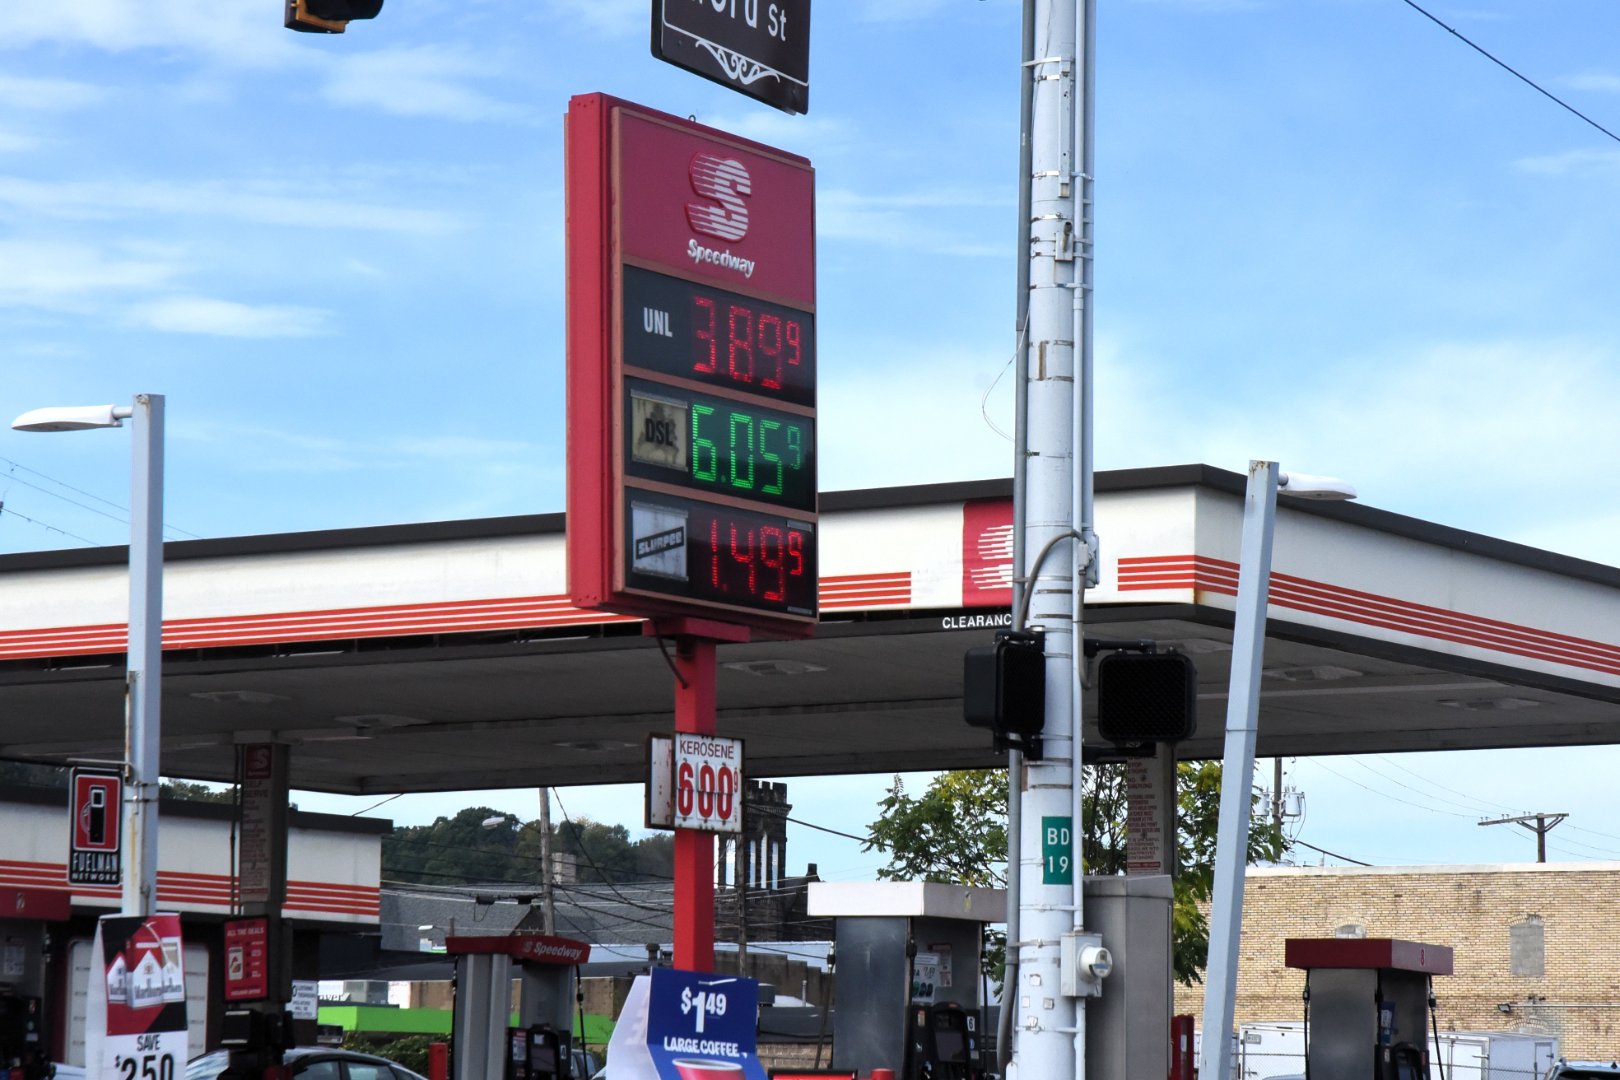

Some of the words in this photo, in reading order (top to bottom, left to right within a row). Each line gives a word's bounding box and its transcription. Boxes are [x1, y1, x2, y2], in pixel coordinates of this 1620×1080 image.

[768, 3, 787, 42] St
[687, 238, 755, 278] Speedway
[643, 306, 673, 338] UNL
[645, 417, 673, 446] DSL
[942, 613, 1012, 629] CLEARANC
[680, 739, 734, 760] KEROSENE
[1047, 827, 1070, 846] BD
[1048, 855, 1069, 874] 19
[71, 872, 118, 881] NETWORK
[534, 942, 582, 961] Speedway
[137, 1034, 161, 1051] SAVE
[664, 1036, 700, 1054] LARGE
[700, 1040, 740, 1058] COFFEE
